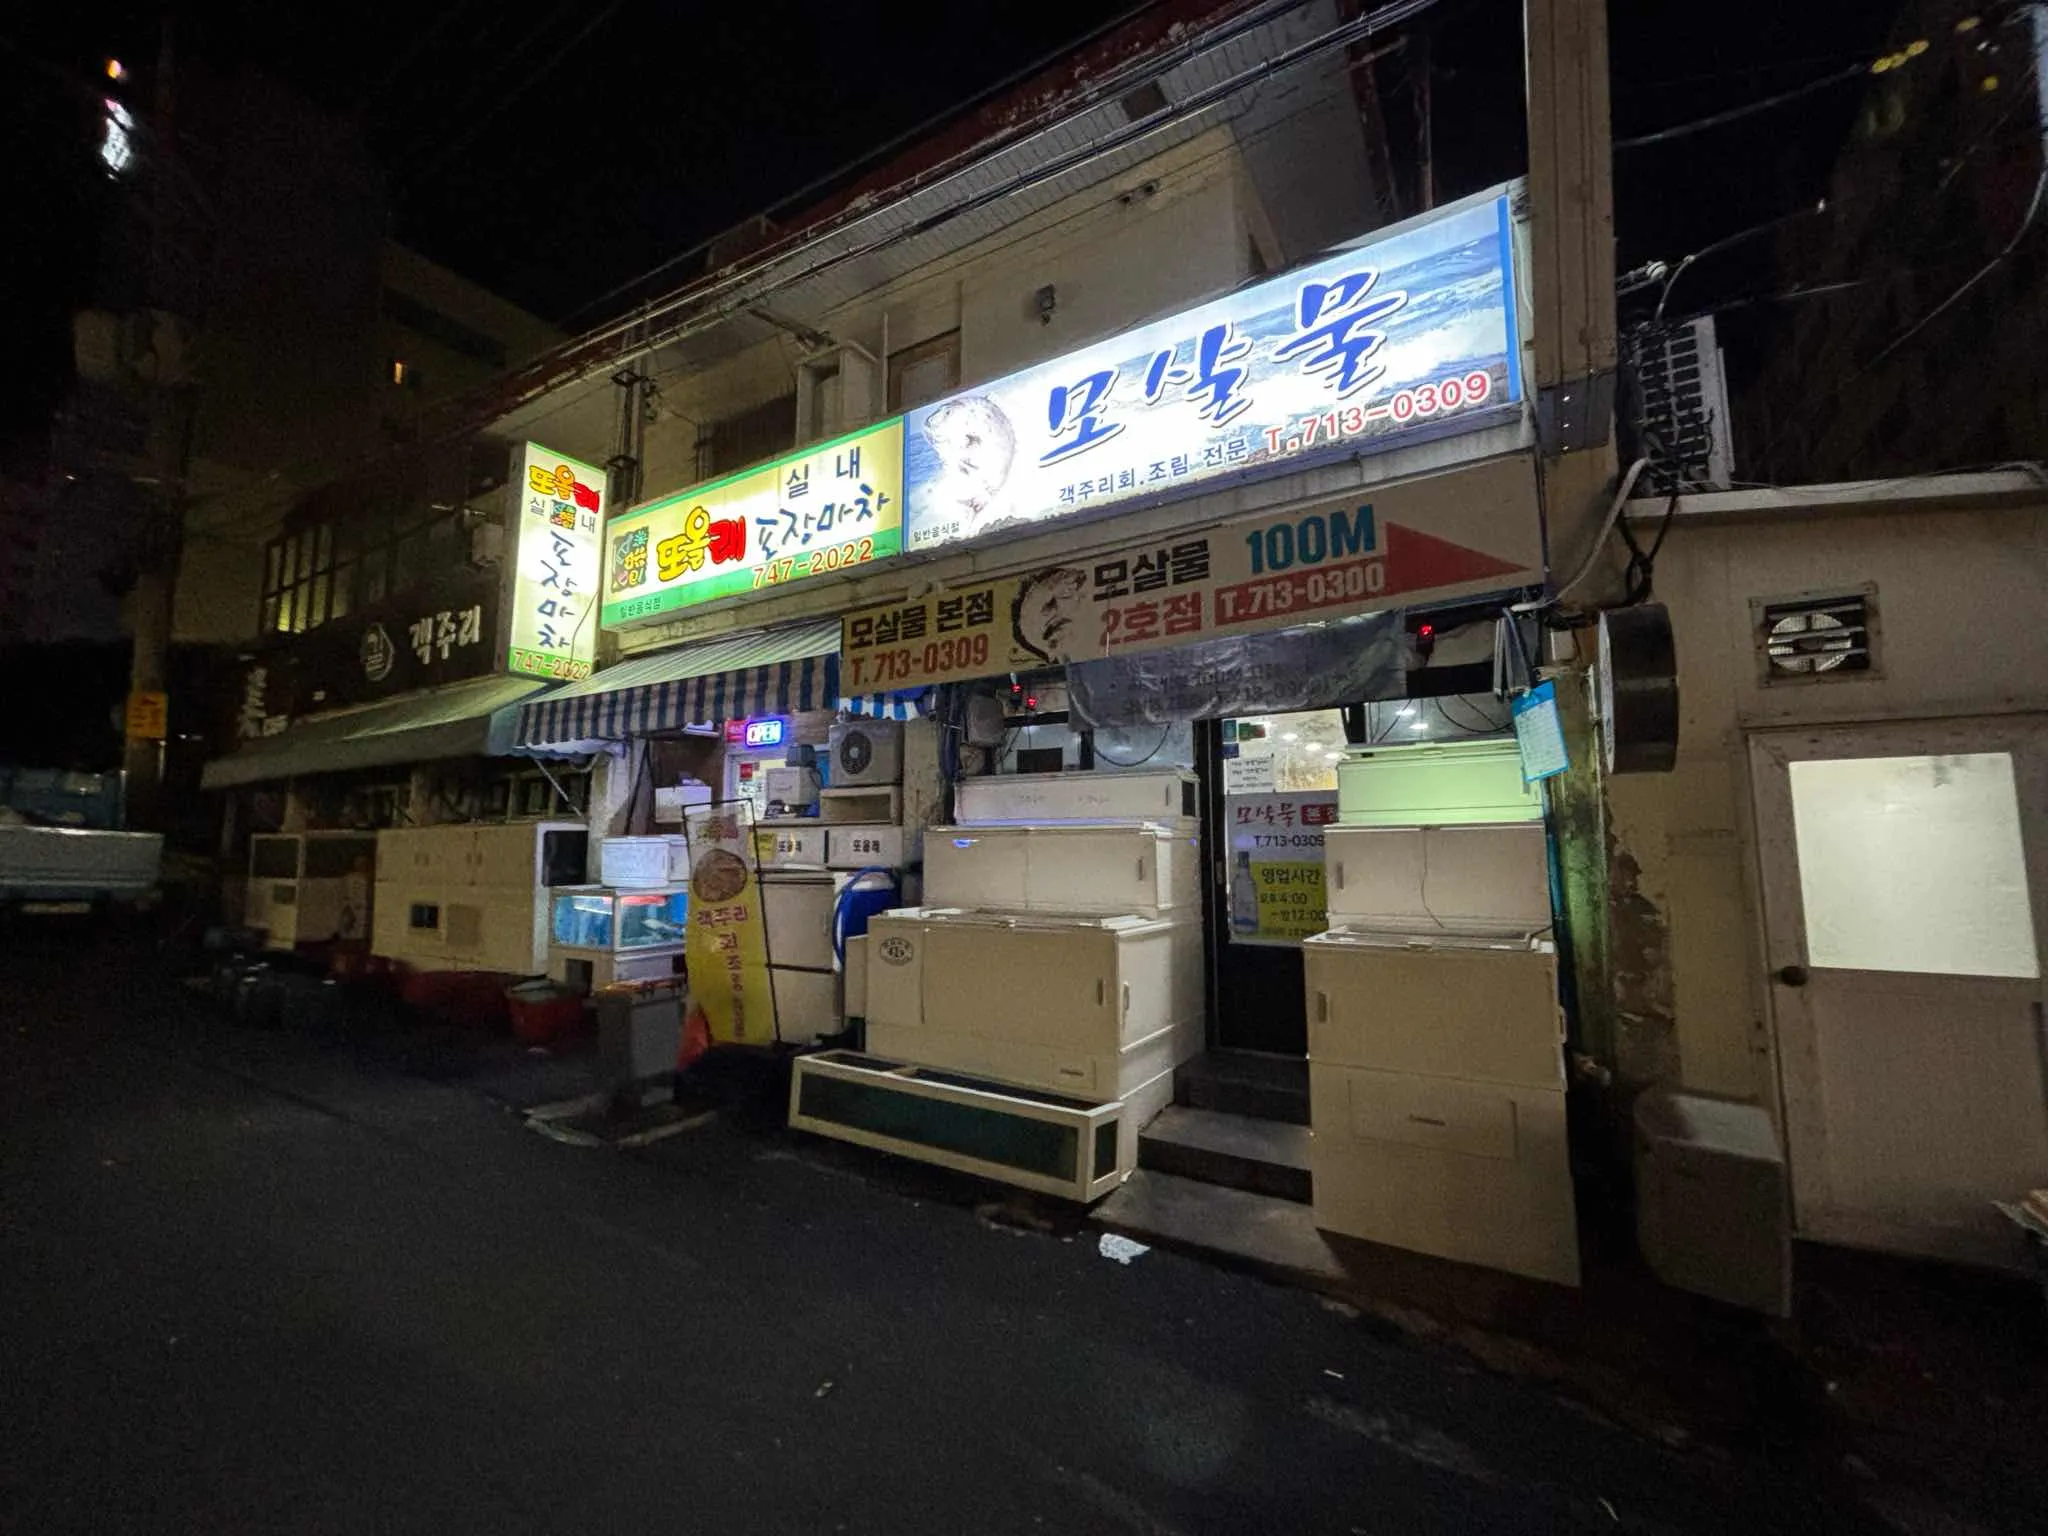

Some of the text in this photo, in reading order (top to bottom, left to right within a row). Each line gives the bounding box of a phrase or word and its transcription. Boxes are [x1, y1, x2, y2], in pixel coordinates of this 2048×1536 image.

[1039, 270, 1406, 464] 모살물
[1265, 374, 1488, 450] T.713-0309
[1204, 437, 1248, 468] 전문
[756, 483, 890, 560] 포장마차
[914, 521, 959, 542] 일반음식점
[1246, 504, 1377, 574] 100M
[538, 531, 577, 648] 포장마차
[753, 539, 872, 587] 747-2022
[1093, 540, 1210, 602] 모살물
[1220, 561, 1386, 618] T.713-0300
[409, 605, 481, 664] 객주리
[850, 589, 994, 649] 모살물 본점
[1101, 592, 1202, 646] 2호점
[513, 652, 591, 680] 747-2022
[851, 633, 989, 686] T.713-0309
[748, 721, 781, 744] OPEN
[1262, 868, 1320, 885] 영업시간
